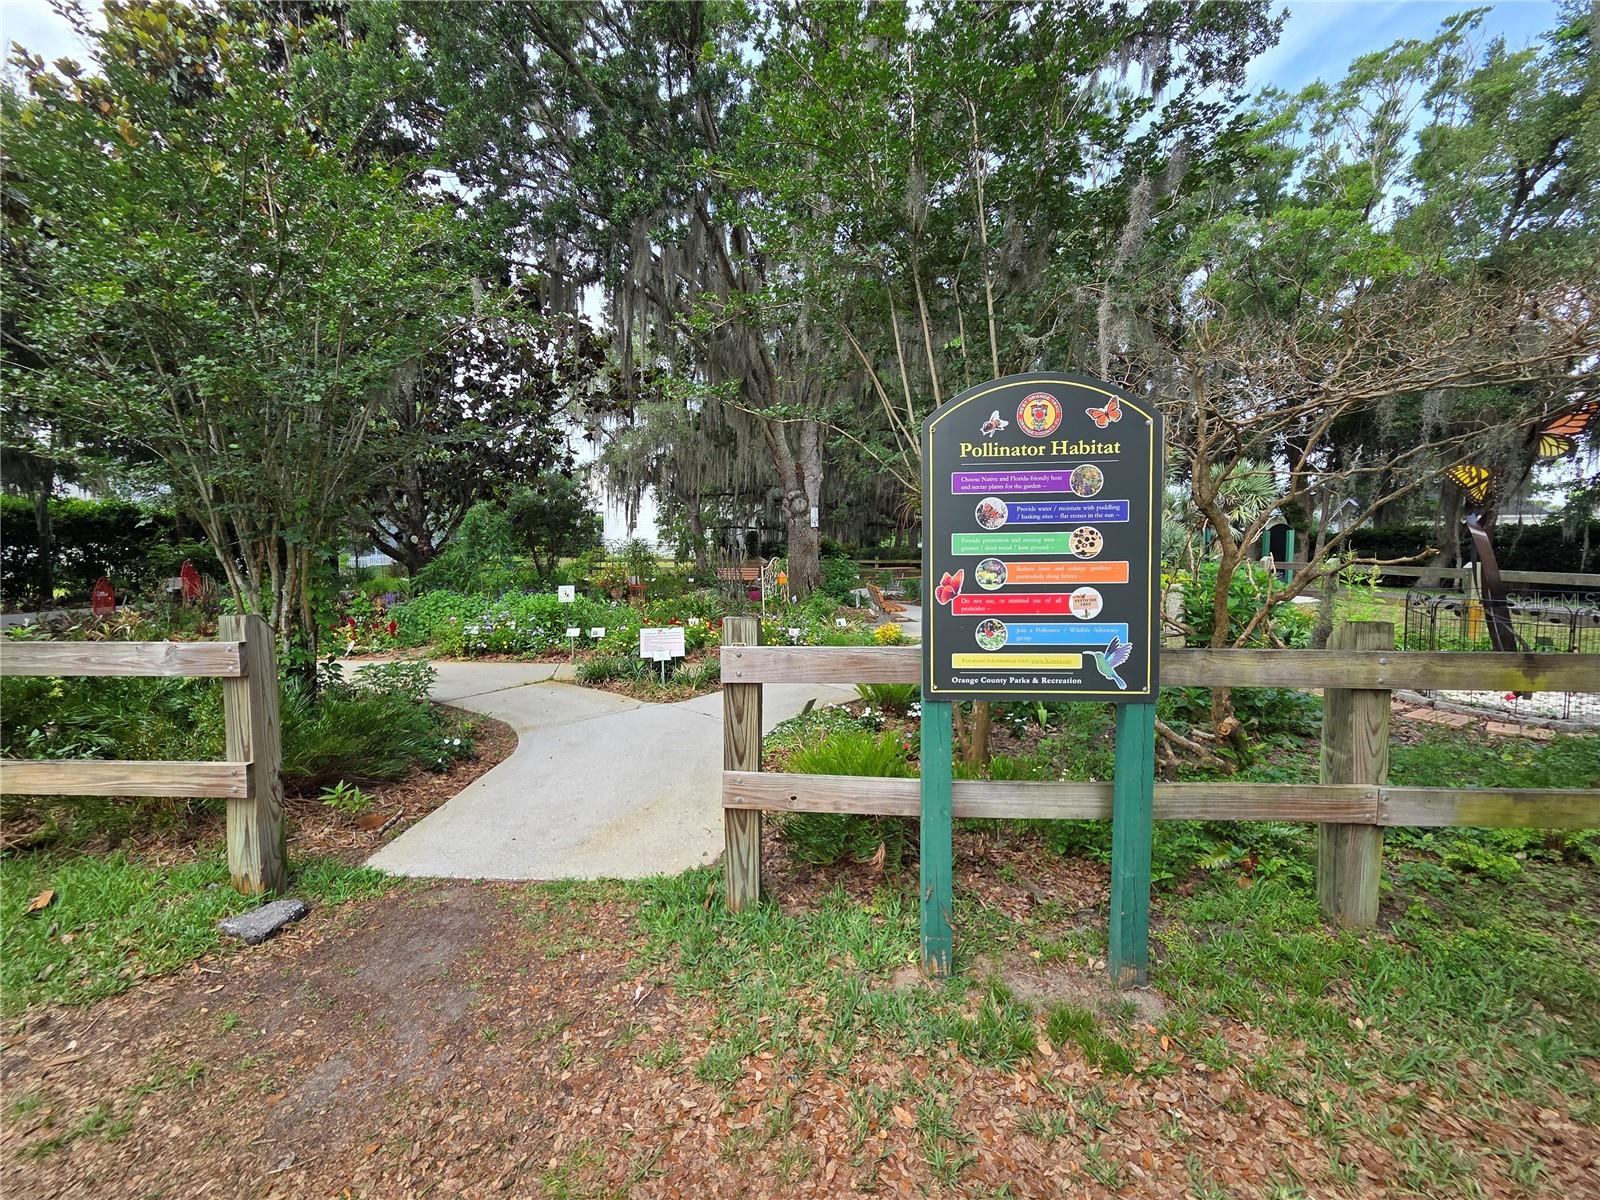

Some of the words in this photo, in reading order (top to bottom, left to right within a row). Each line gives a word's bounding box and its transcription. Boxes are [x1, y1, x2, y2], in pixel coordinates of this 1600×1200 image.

[959, 441, 1046, 457] Pollinator
[1050, 440, 1121, 456] Habitat
[1096, 504, 1120, 512] puddling
[951, 676, 979, 685] Orange
[980, 676, 1007, 685] County
[1009, 676, 1030, 684] Parks
[1032, 676, 1039, 684] &
[1041, 676, 1082, 684] Recreation
